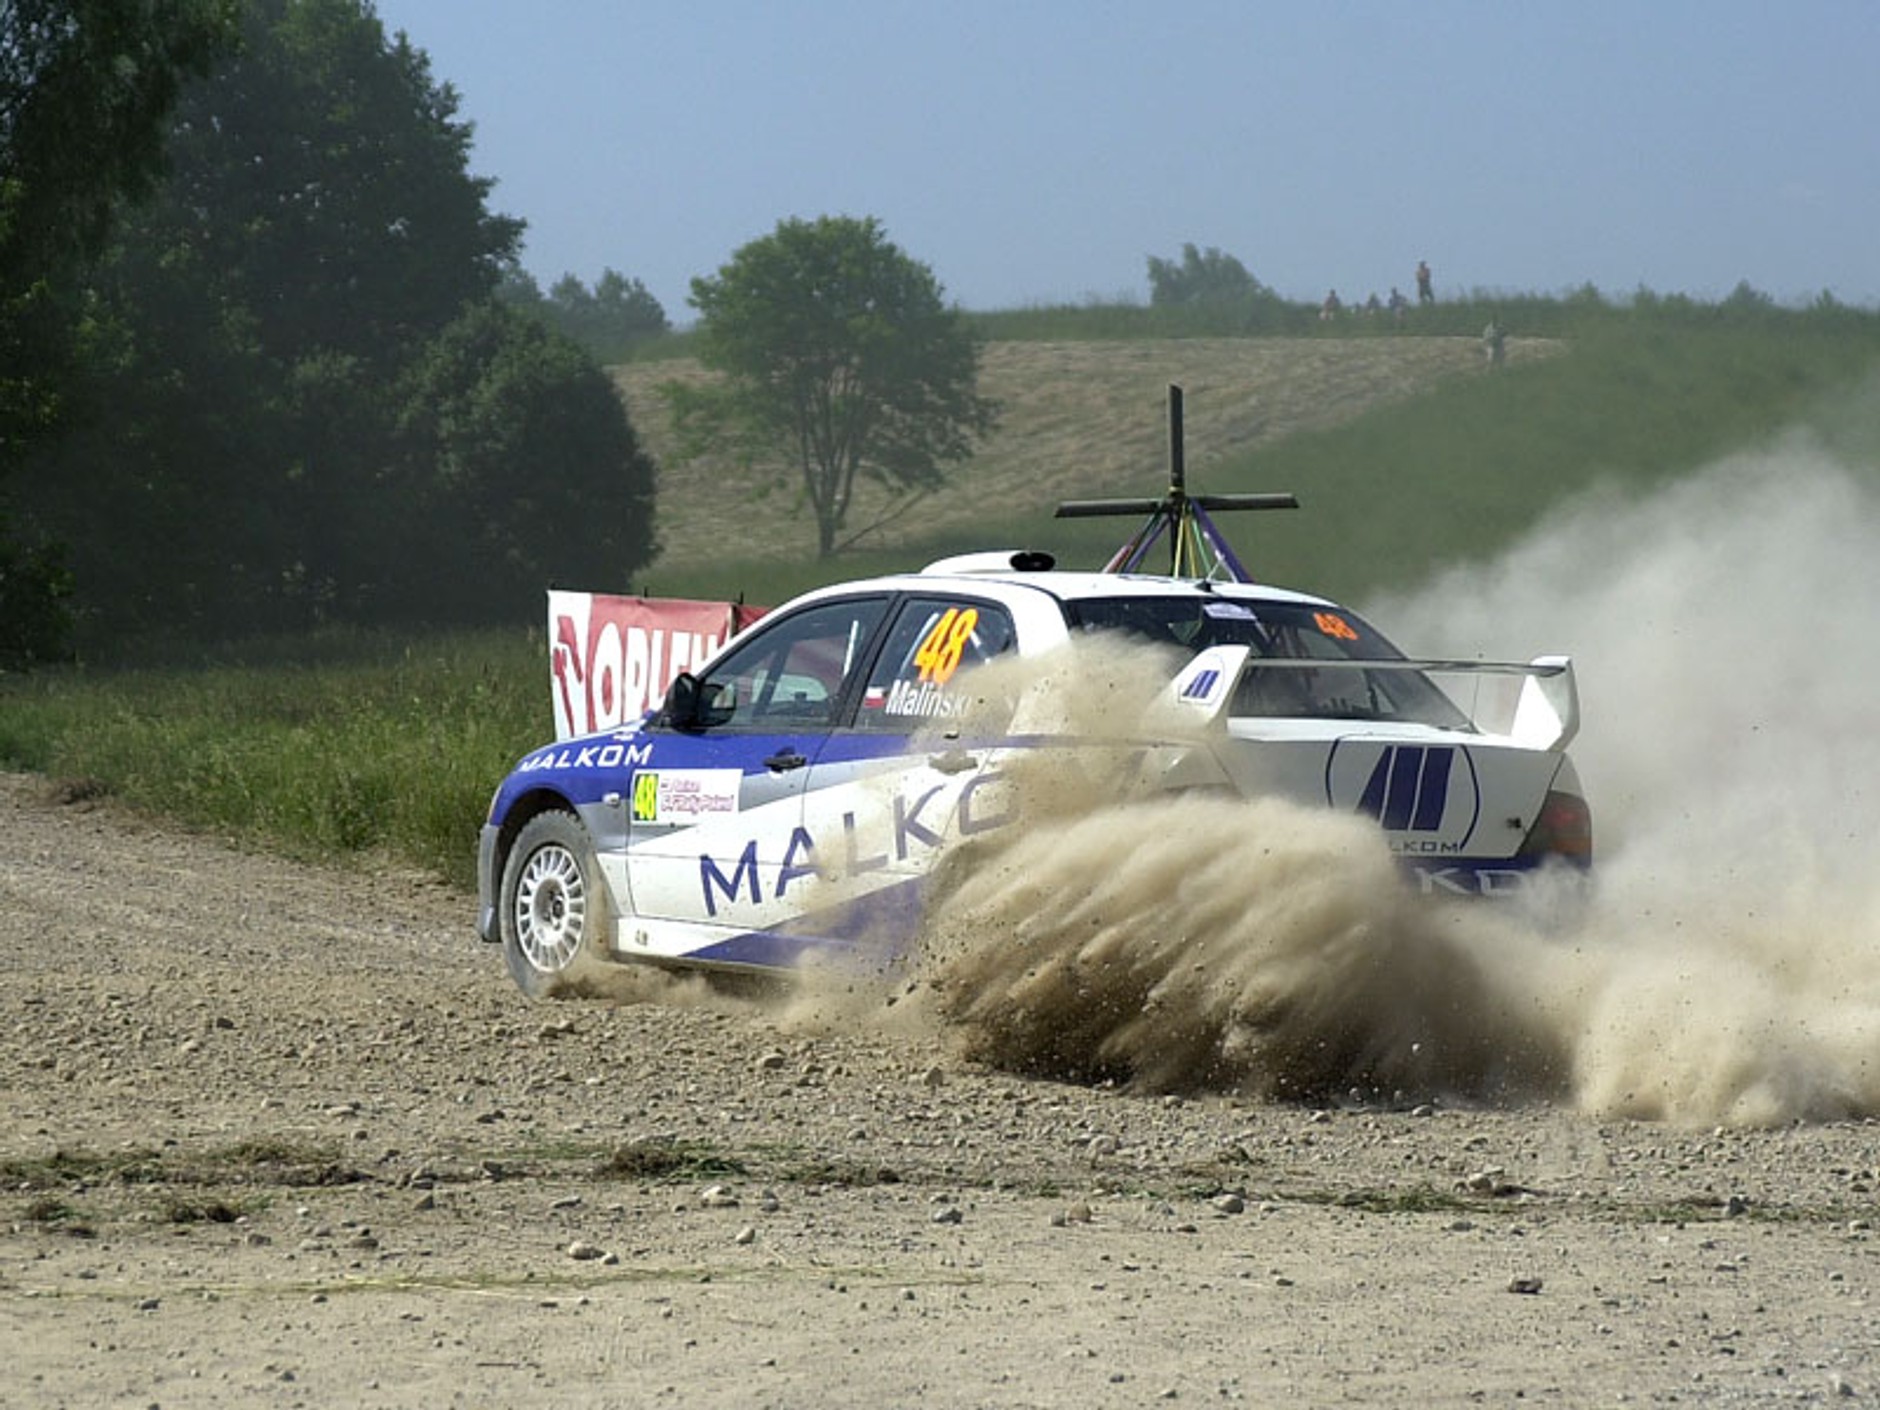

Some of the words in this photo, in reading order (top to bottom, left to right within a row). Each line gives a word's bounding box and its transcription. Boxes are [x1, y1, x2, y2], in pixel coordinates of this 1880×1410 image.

[913, 606, 980, 684] 48
[634, 774, 658, 821] 48
[700, 770, 1020, 917] MALKO
